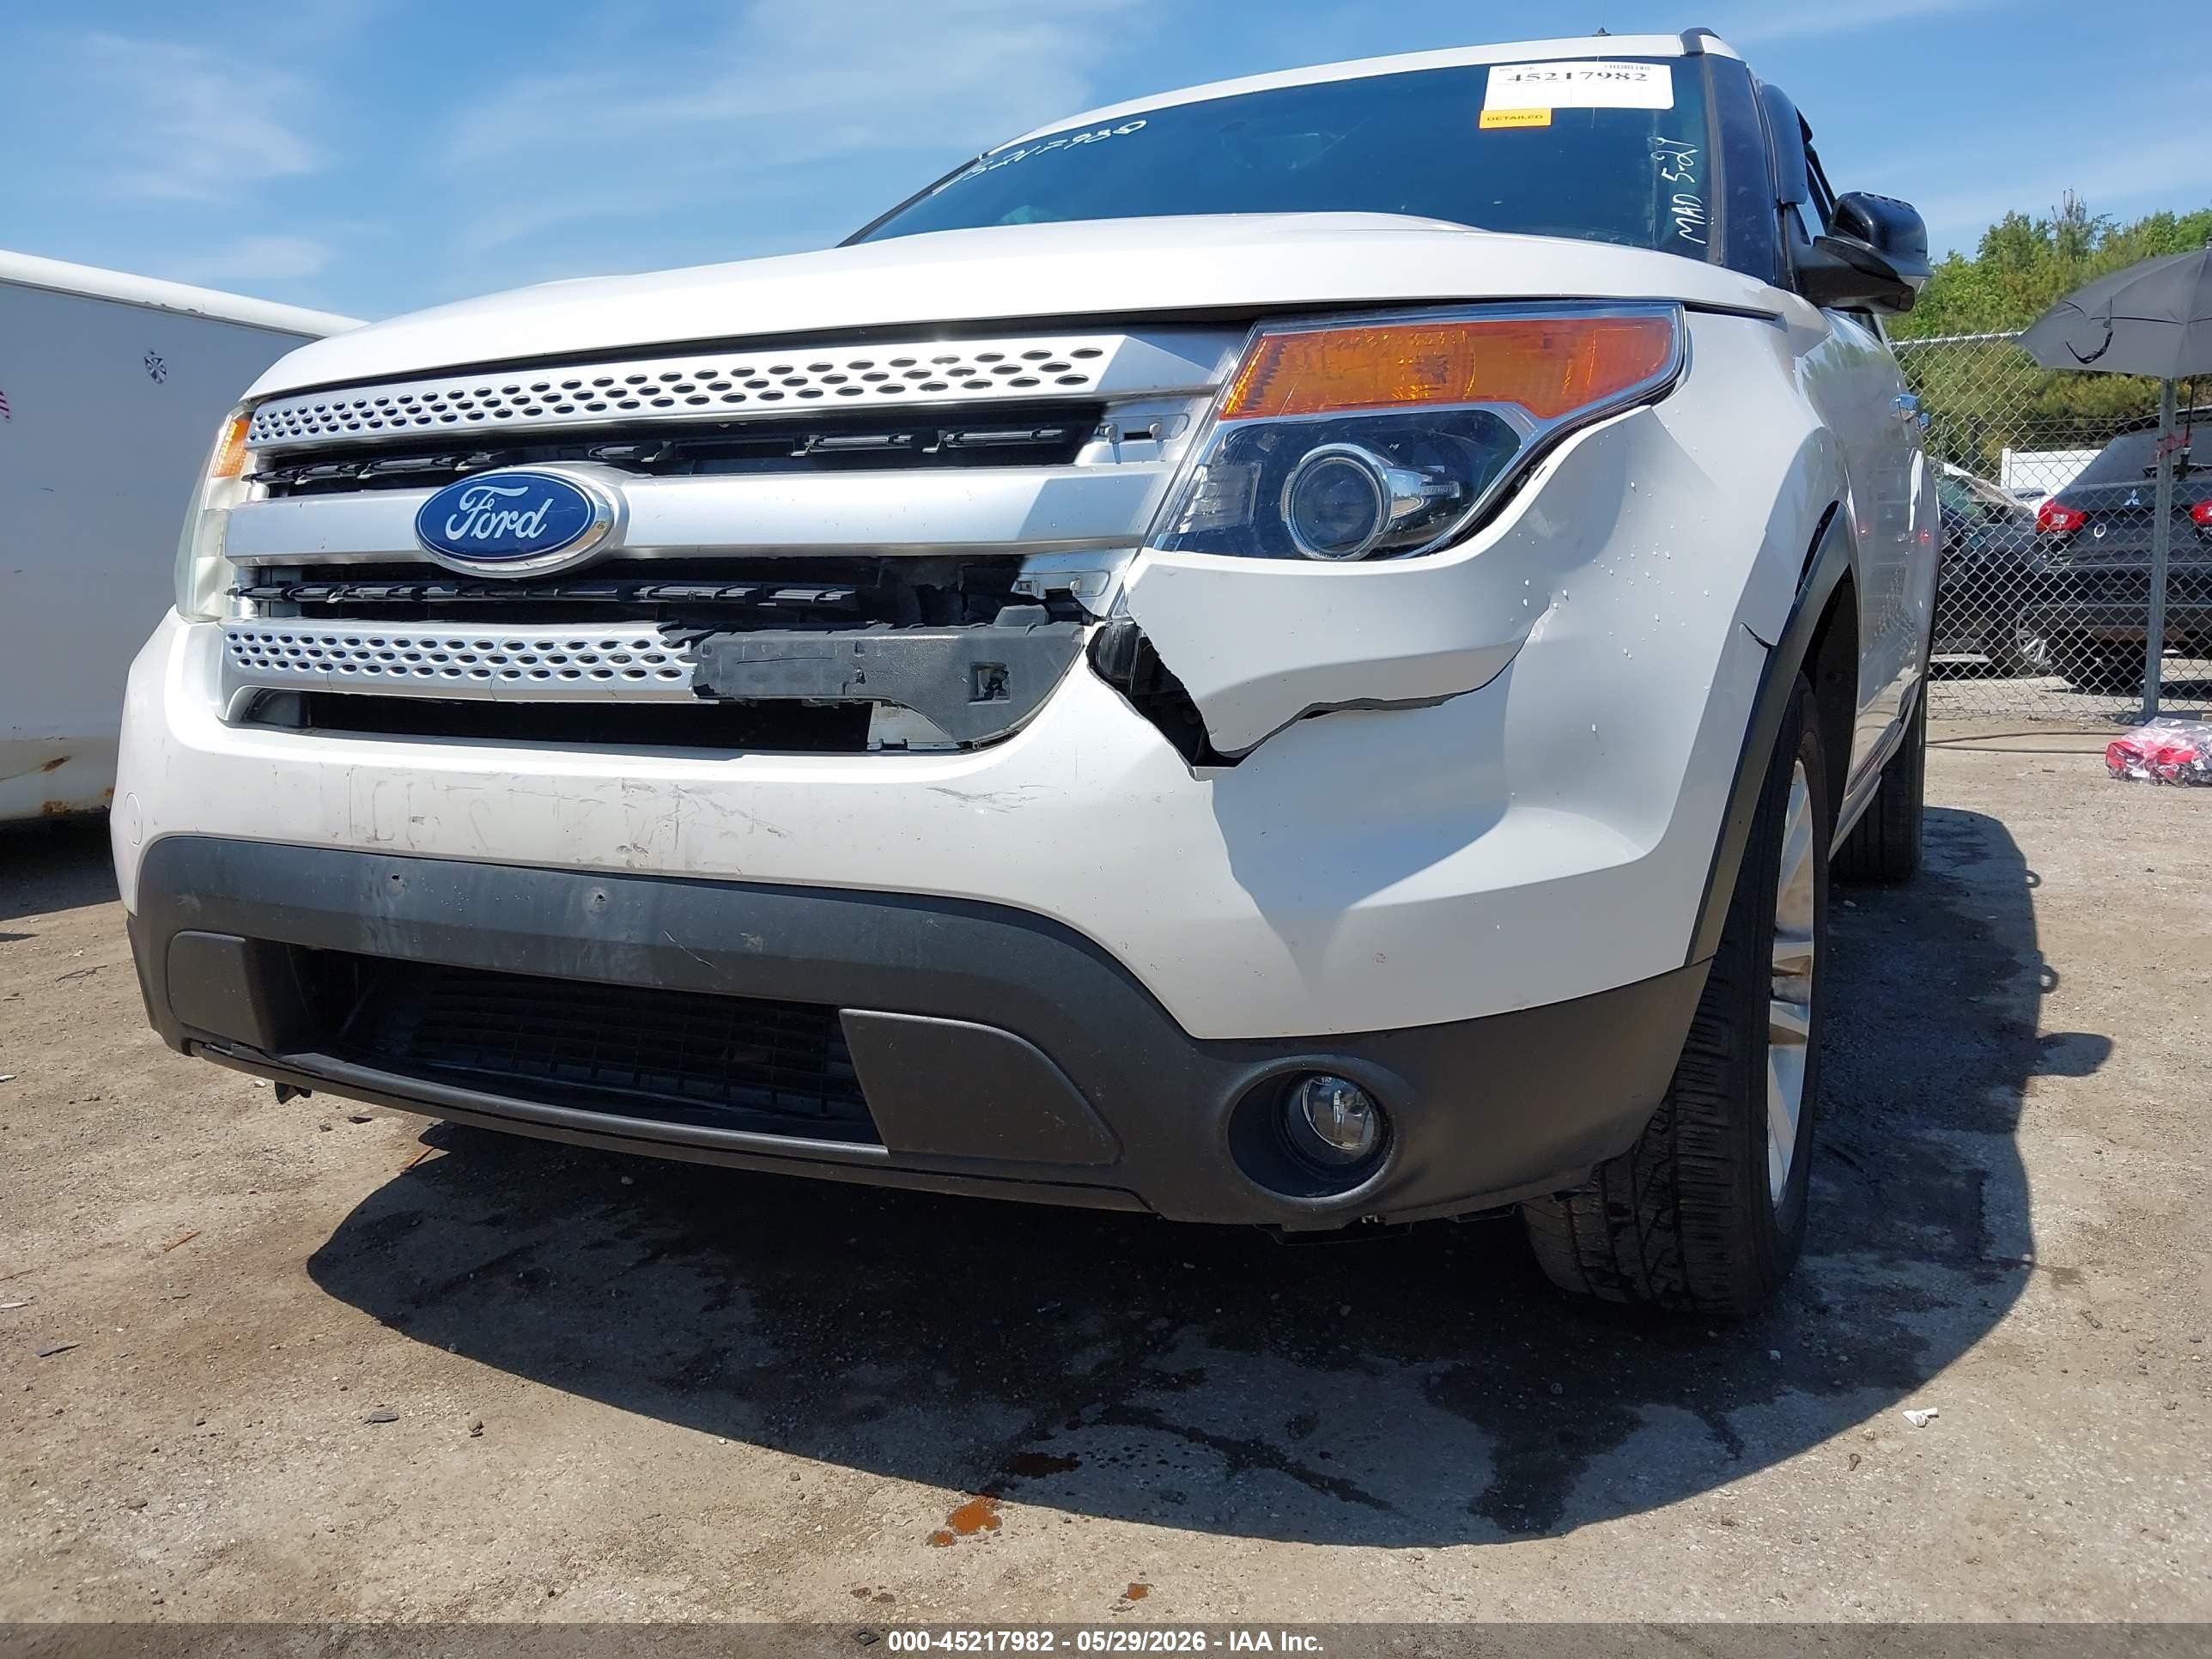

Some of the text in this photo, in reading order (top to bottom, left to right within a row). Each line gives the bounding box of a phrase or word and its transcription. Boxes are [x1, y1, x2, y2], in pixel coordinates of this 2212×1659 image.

[1507, 70, 1649, 82] 45217982
[1670, 193, 1707, 245] MAD
[445, 485, 555, 541] Ford
